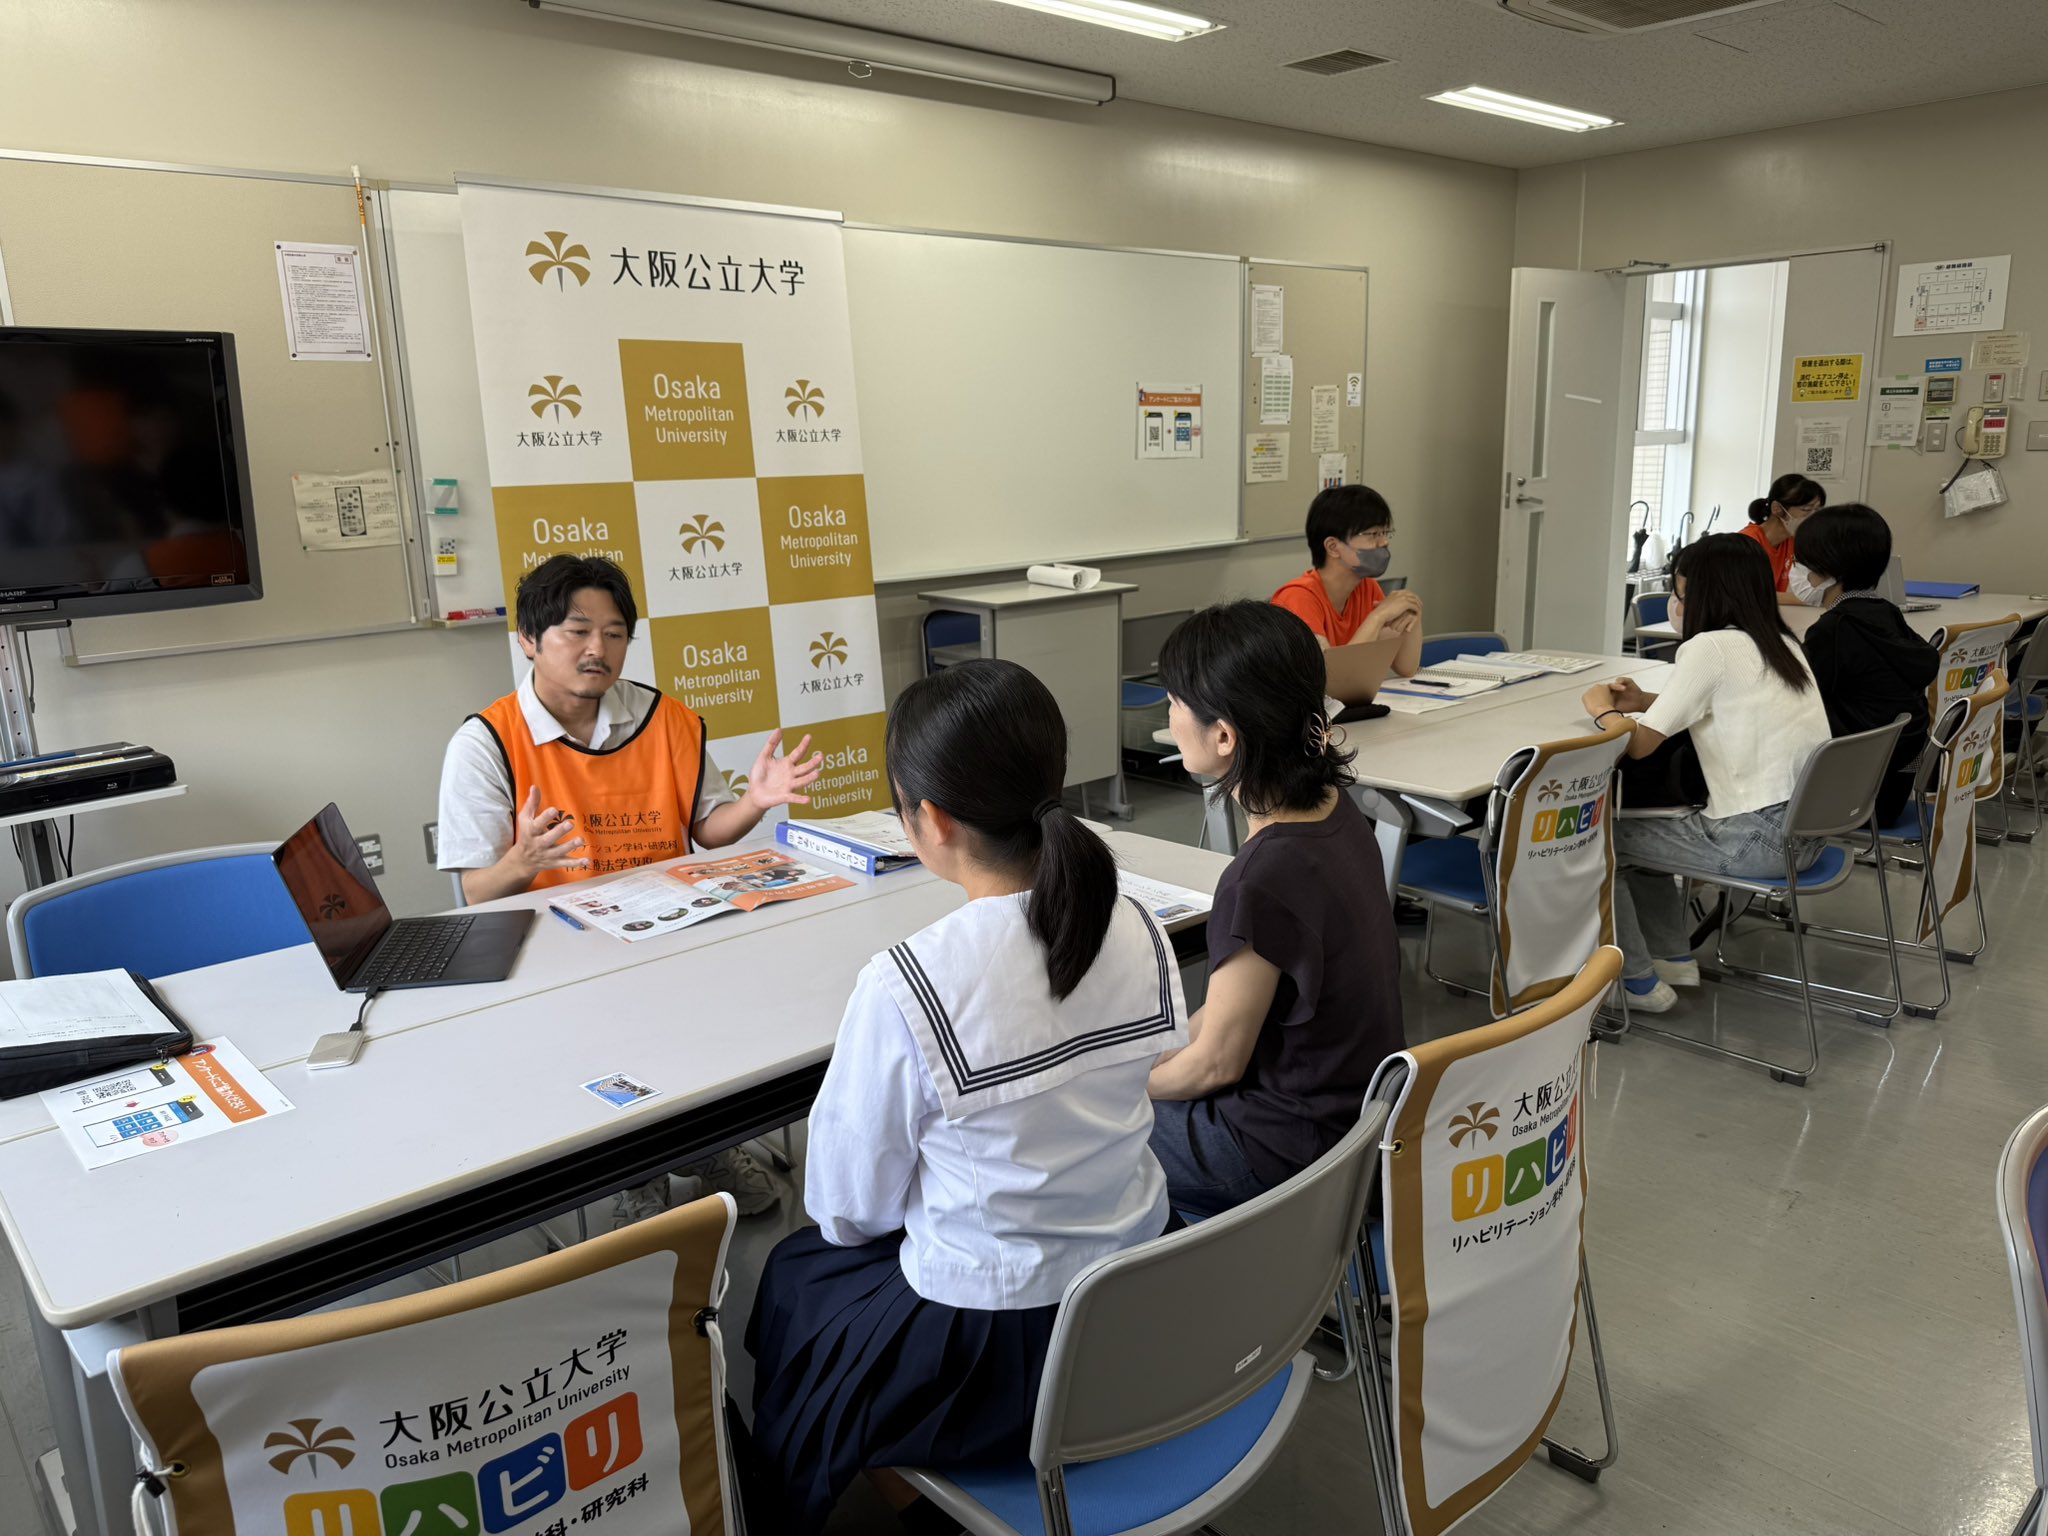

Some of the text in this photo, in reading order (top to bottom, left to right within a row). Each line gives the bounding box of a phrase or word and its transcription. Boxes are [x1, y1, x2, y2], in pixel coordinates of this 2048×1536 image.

[609, 246, 806, 297] 大阪公立大学
[653, 372, 721, 400] Osaka
[644, 405, 735, 425] Metropolitan
[516, 430, 603, 448] 大阪公立大学
[656, 426, 728, 446] University
[775, 428, 842, 444] 大阪公立大学
[788, 505, 847, 529] Osaka
[533, 517, 609, 544] Osaka
[780, 531, 859, 551] Metropolitan
[790, 549, 853, 569] University
[668, 562, 744, 582] 大阪公立大学
[0, 590, 27, 598] HARP
[683, 641, 748, 670] Osaka
[674, 666, 761, 692] Metropolitan
[799, 672, 865, 696] 大阪公立大学
[684, 688, 754, 710] University
[811, 745, 870, 778] Osaka
[804, 768, 880, 794] Metropolitan
[812, 786, 874, 811] University
[1537, 800, 1602, 841] リハビリ
[1512, 1119, 1538, 1138] Osaka
[1463, 1098, 1576, 1216] リハビリ
[379, 1327, 629, 1449] 大阪公立大学
[384, 1363, 632, 1470] Osaka Metropolitan University
[534, 1472, 650, 1536] 科・研究科
